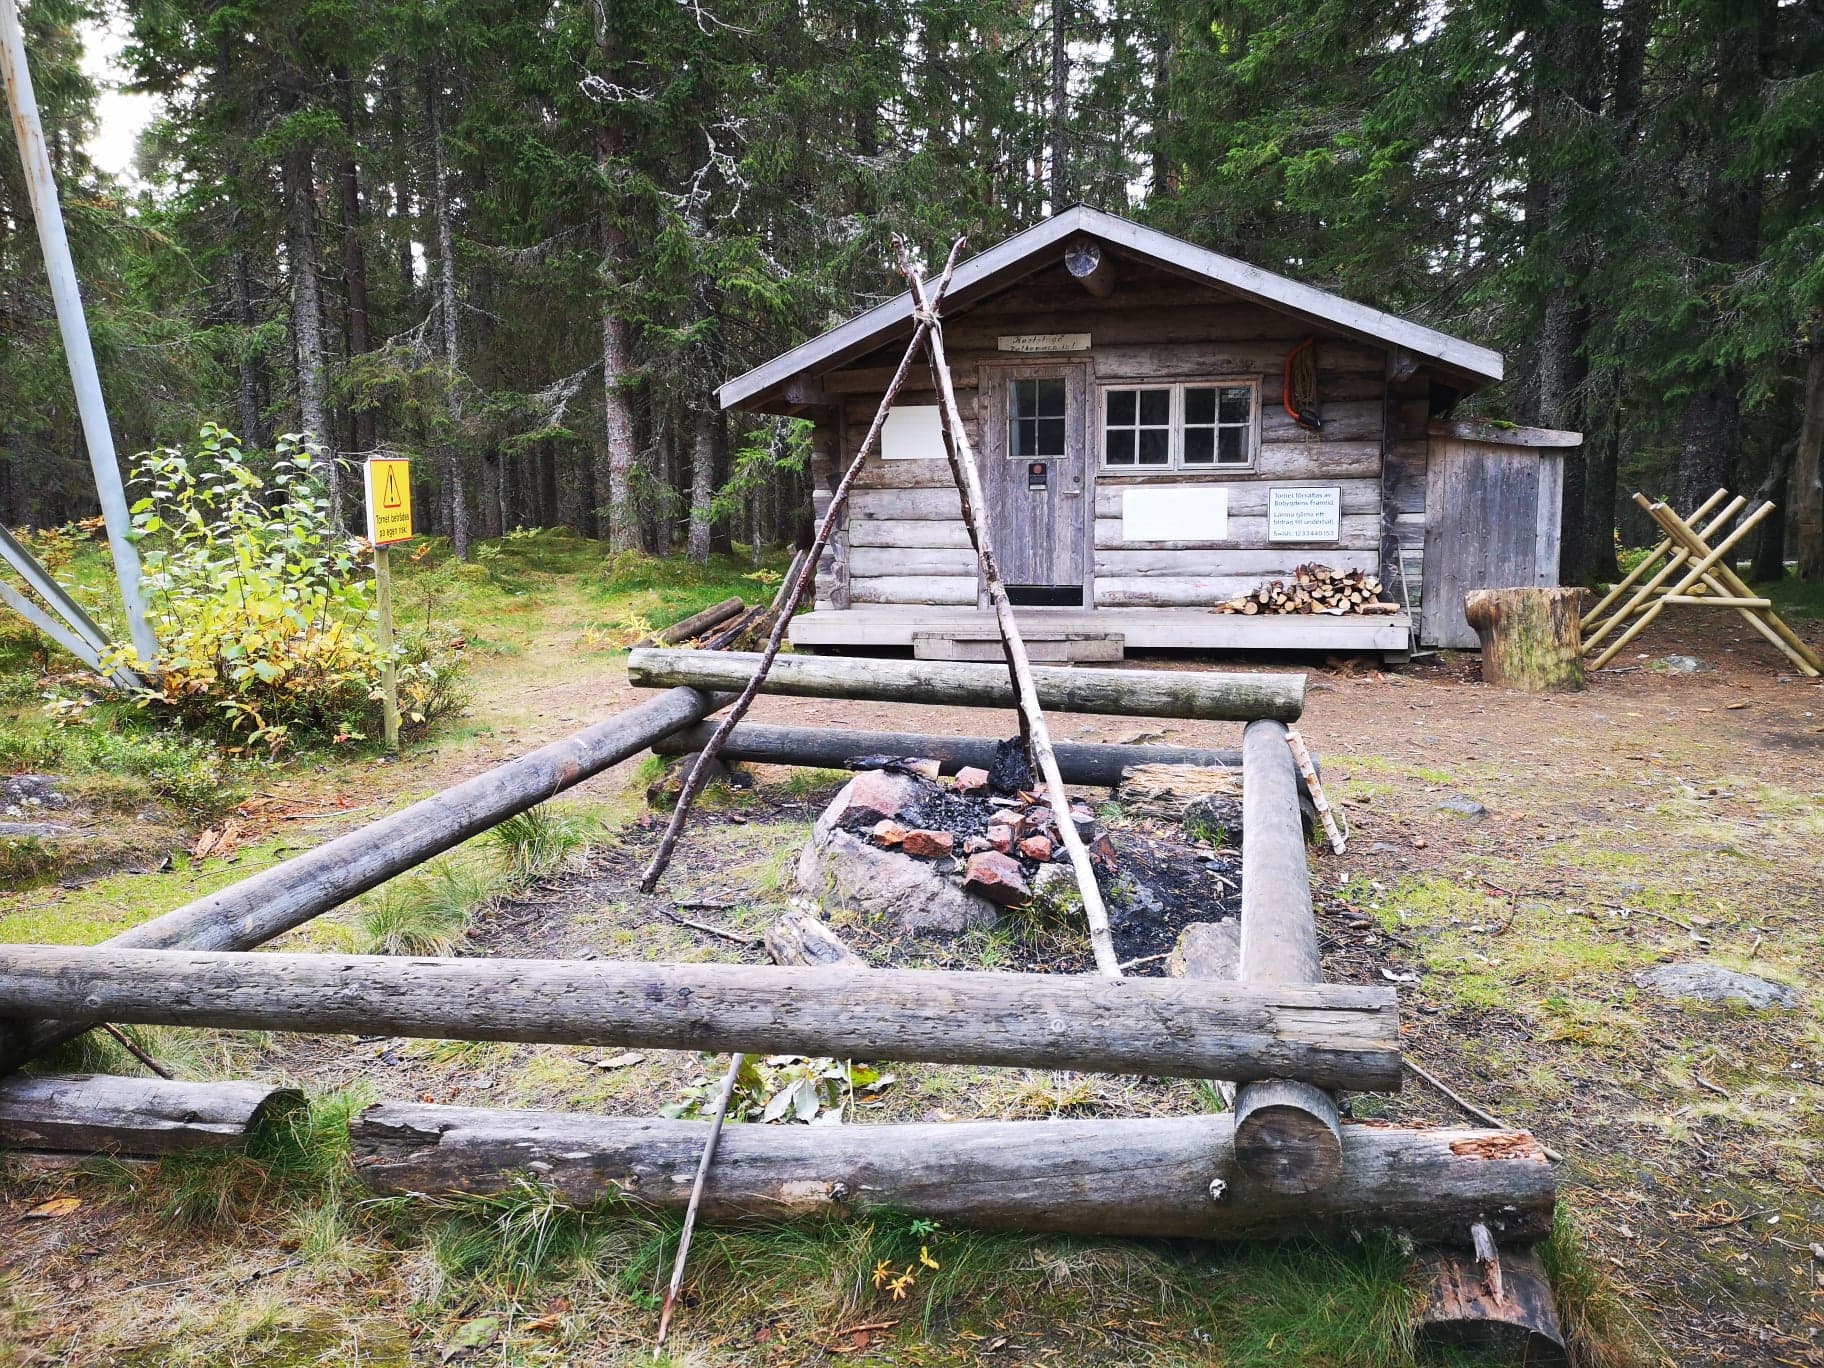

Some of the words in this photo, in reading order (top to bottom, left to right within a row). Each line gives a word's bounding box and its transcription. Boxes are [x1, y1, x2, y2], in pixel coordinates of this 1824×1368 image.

[375, 513, 390, 525] Tornet
[390, 511, 410, 523] beträdes
[379, 527, 386, 538] på
[386, 527, 398, 538] egen
[398, 524, 408, 535] risk!
